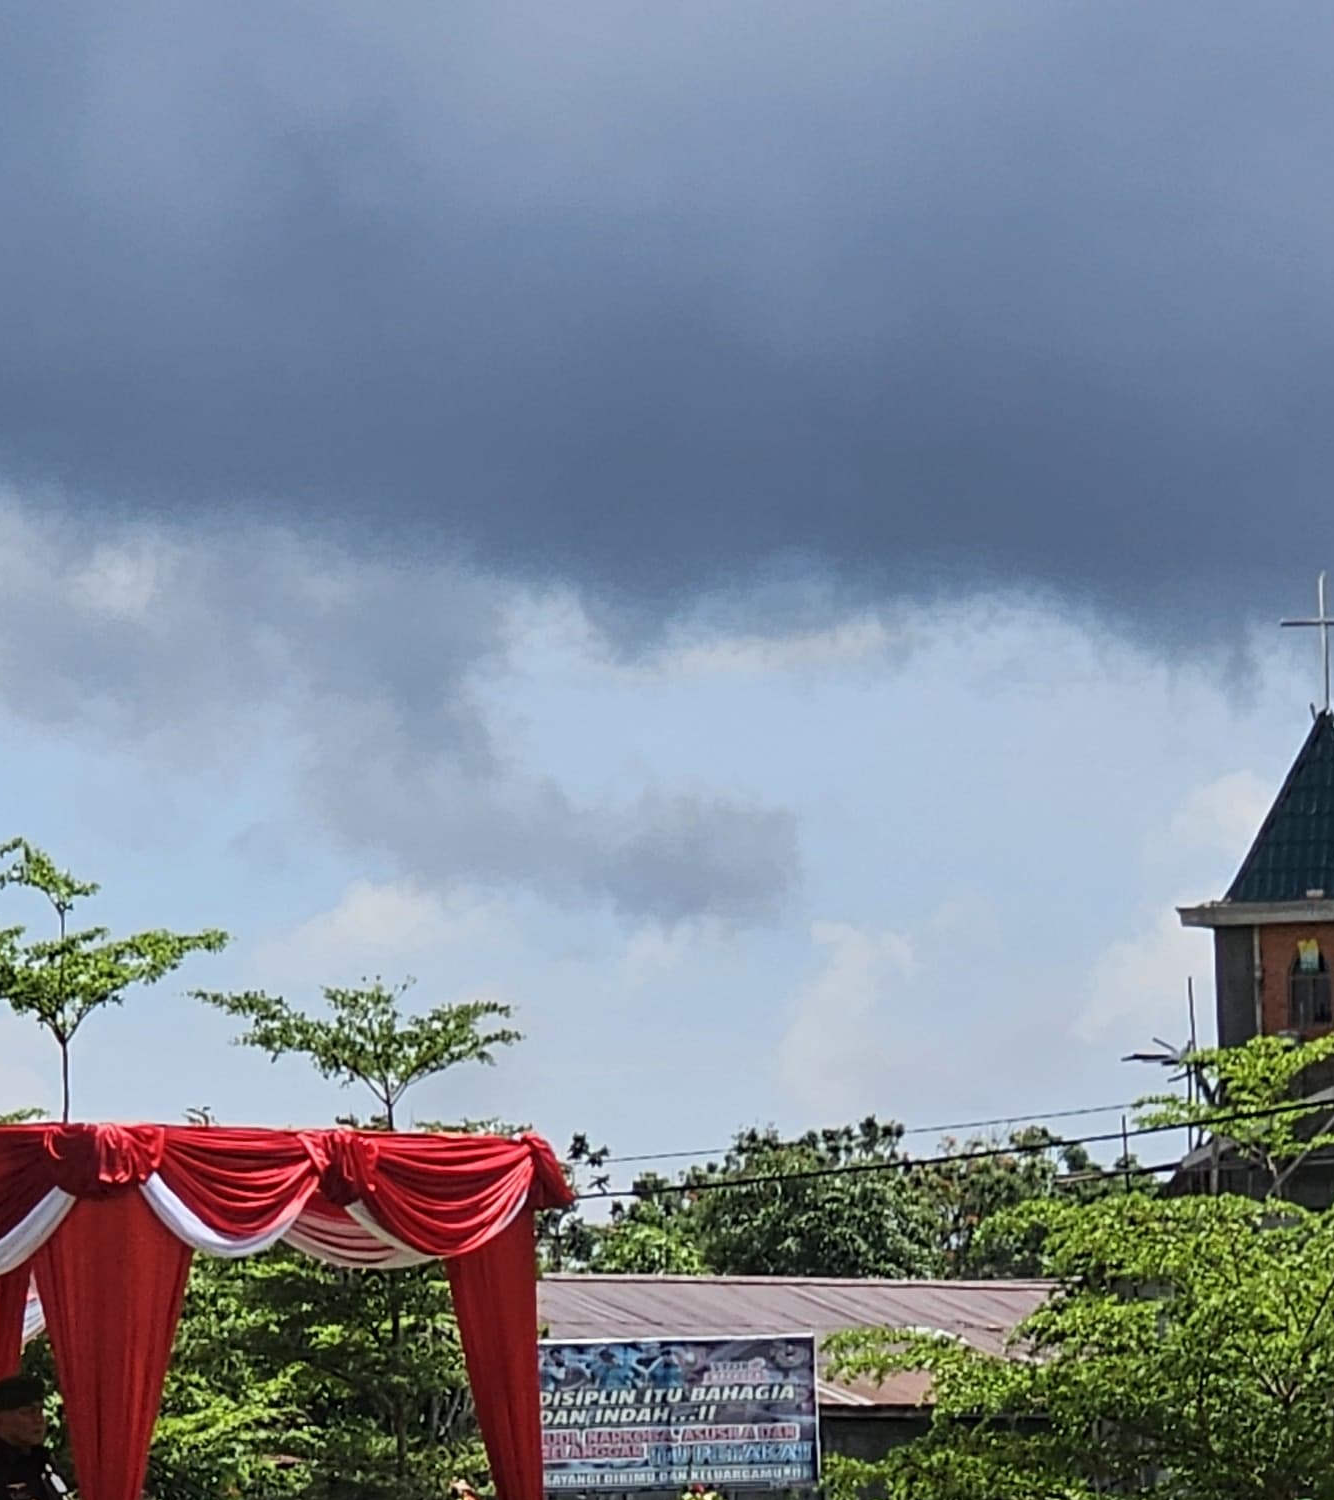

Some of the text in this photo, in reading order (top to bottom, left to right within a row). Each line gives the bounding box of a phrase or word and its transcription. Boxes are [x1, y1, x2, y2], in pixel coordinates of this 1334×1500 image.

[540, 1384, 795, 1407] DISIPLIN ITU BAHAGIA
[540, 1408, 586, 1426] DAN
[757, 1424, 797, 1440] DAN
[604, 1472, 655, 1486] DIRIMU
